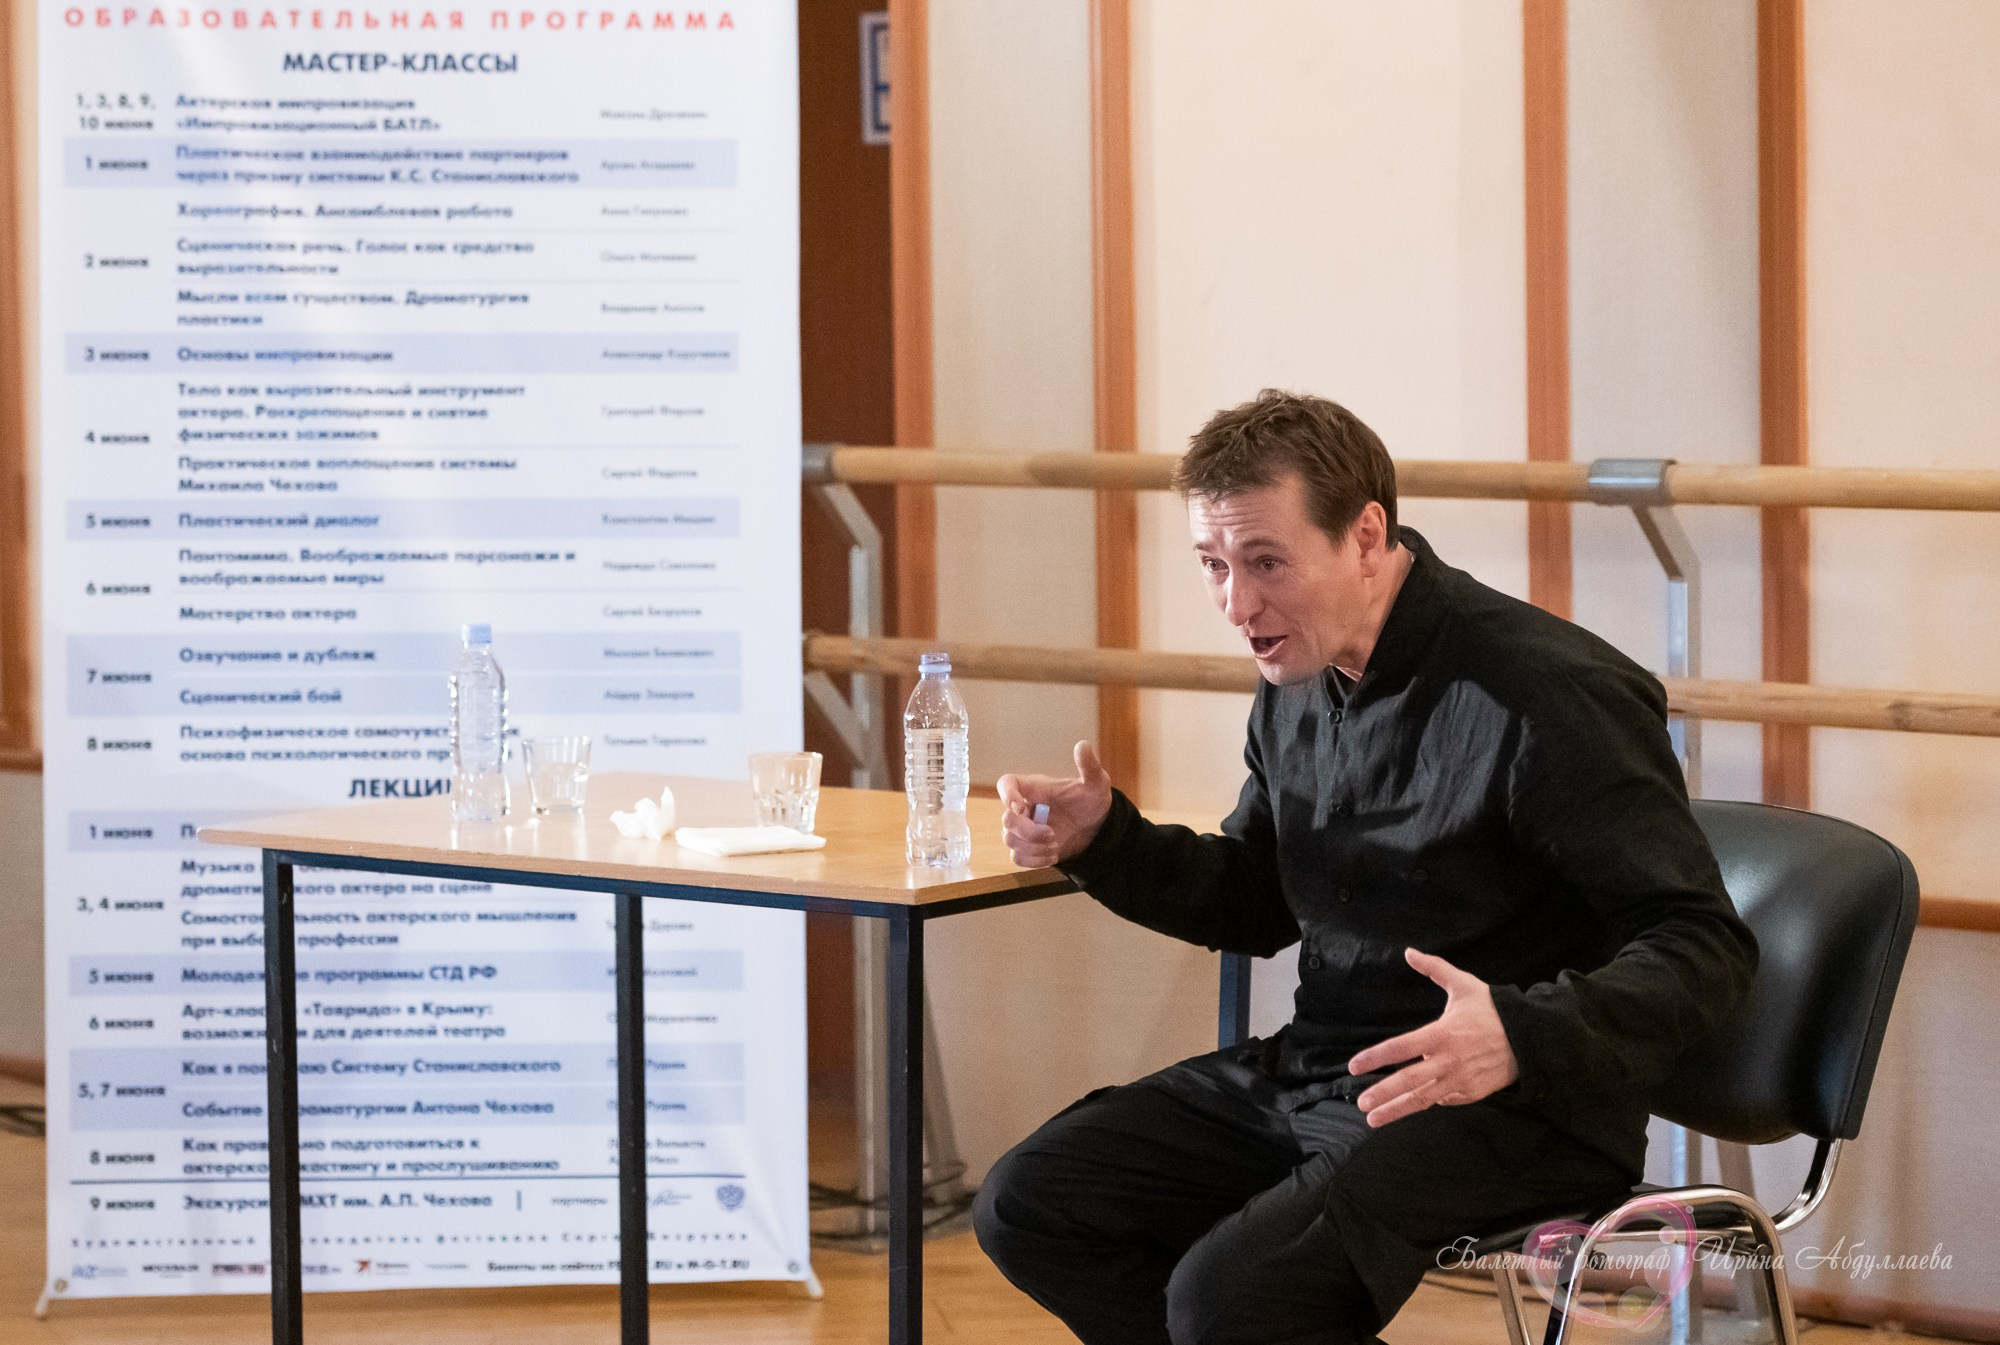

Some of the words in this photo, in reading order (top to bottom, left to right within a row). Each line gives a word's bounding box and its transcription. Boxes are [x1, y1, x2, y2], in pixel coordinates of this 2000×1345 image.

[62, 6, 464, 30] ОБРАЗОВАТЕЛЬНАЯ
[489, 9, 735, 31] ПРОГРАММА
[281, 52, 518, 73] МАСТЕР-КЛАССЫ
[348, 777, 452, 800] ЛЕКЦИ
[179, 859, 255, 876] Музыка
[339, 883, 407, 898] актера
[438, 883, 494, 896] сцене
[113, 900, 165, 911] июня
[364, 912, 472, 926] актерского
[474, 911, 578, 922] мышления
[180, 936, 217, 951] при
[296, 932, 399, 949] профессии
[102, 971, 155, 984] июня
[313, 969, 425, 985] программы
[427, 965, 465, 982] СТД
[302, 1001, 402, 1019] «Таврида»
[421, 1001, 492, 1019] Крыму:
[103, 1018, 155, 1030] июня
[311, 1027, 347, 1041] для
[349, 1024, 438, 1040] деятелей
[442, 1026, 506, 1040] театра
[180, 1060, 218, 1076] Как
[329, 1058, 409, 1077] Систему
[411, 1058, 562, 1073] Станиславского
[114, 1085, 166, 1097] июня
[180, 1101, 264, 1118] Событие
[410, 1100, 481, 1115] Антона
[483, 1099, 555, 1114] Чехова
[181, 1138, 218, 1152] Как
[329, 1139, 465, 1152] подготовиться
[104, 1153, 156, 1164] июня
[300, 1161, 380, 1178] кастингу
[401, 1158, 561, 1177] прослушиванию
[104, 1199, 156, 1211] июня
[182, 1194, 270, 1213] Экскурси
[300, 1193, 338, 1208] МХТ
[341, 1197, 373, 1208] им.
[378, 1192, 418, 1207] А.П.
[422, 1193, 493, 1207] Чехова
